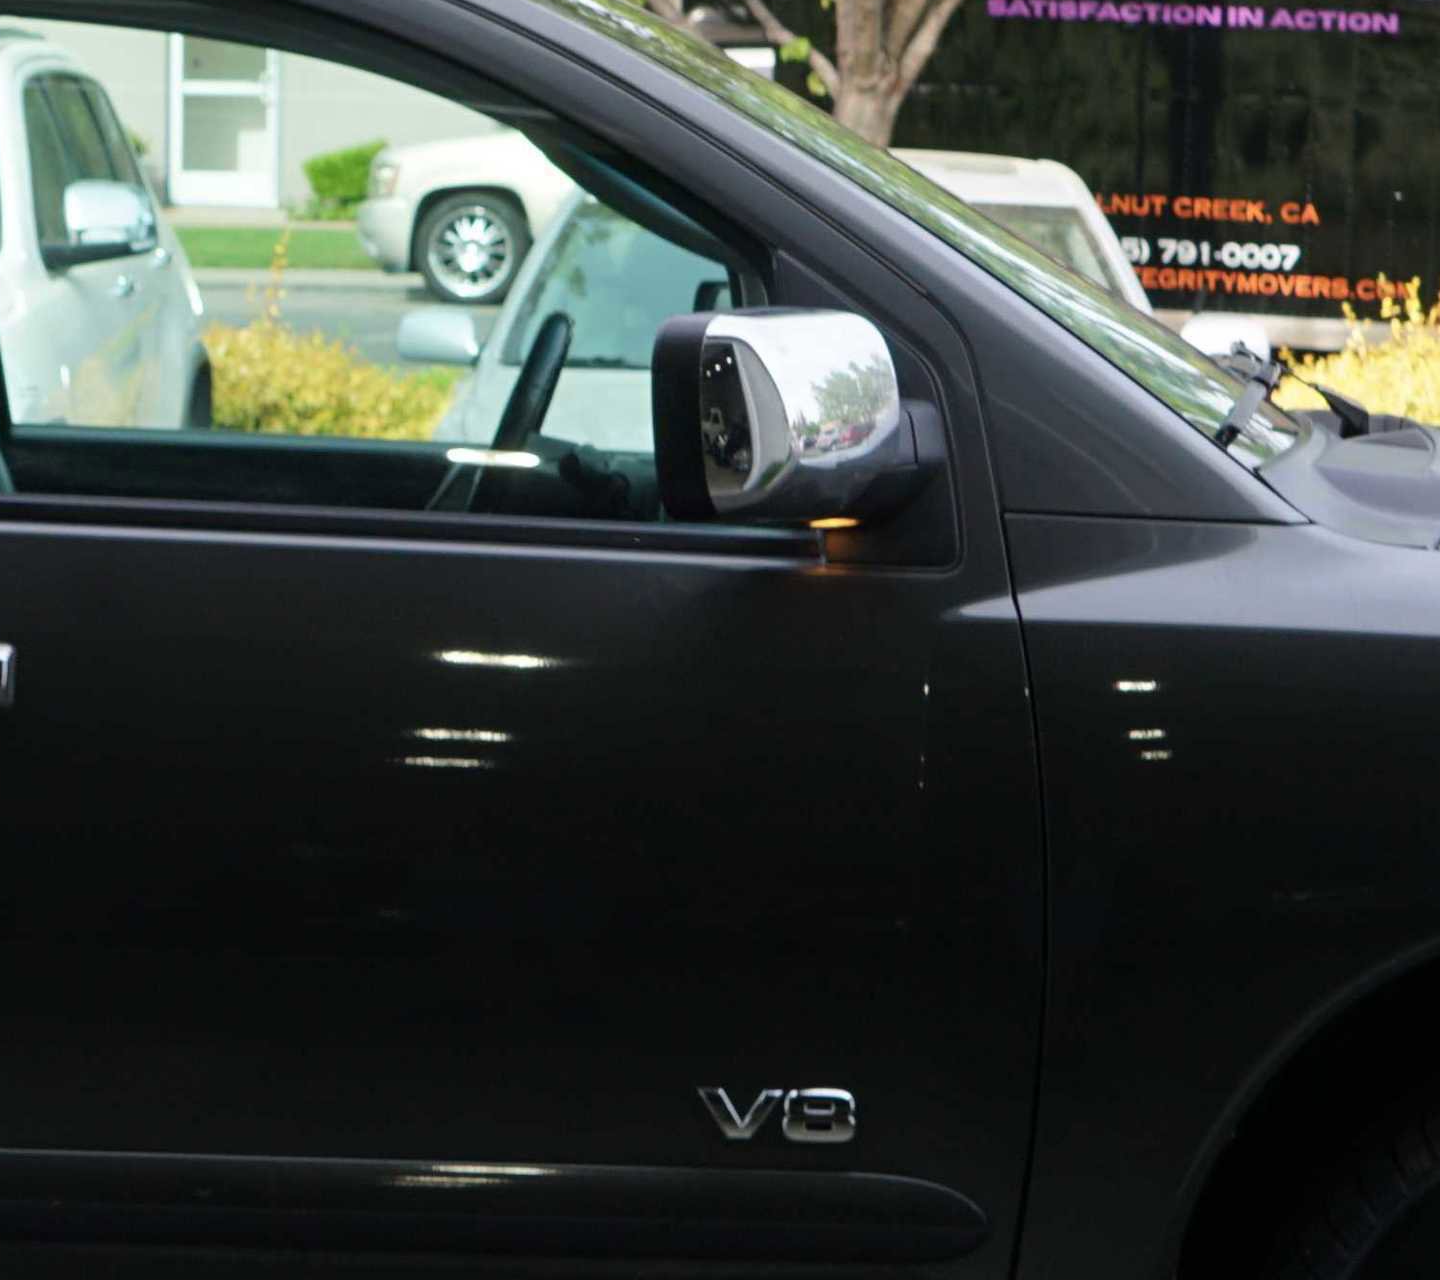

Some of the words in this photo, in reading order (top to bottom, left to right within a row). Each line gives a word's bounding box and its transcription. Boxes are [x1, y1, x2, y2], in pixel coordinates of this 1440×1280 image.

[1226, 5, 1265, 28] IN
[1269, 7, 1400, 35] ACTION
[1094, 192, 1168, 217] LNUT
[1173, 195, 1274, 224] CREEK,
[1279, 201, 1320, 225] CA
[1121, 236, 1151, 266] 5)
[1157, 237, 1302, 271] 791-0007
[696, 1086, 856, 1143] V8
